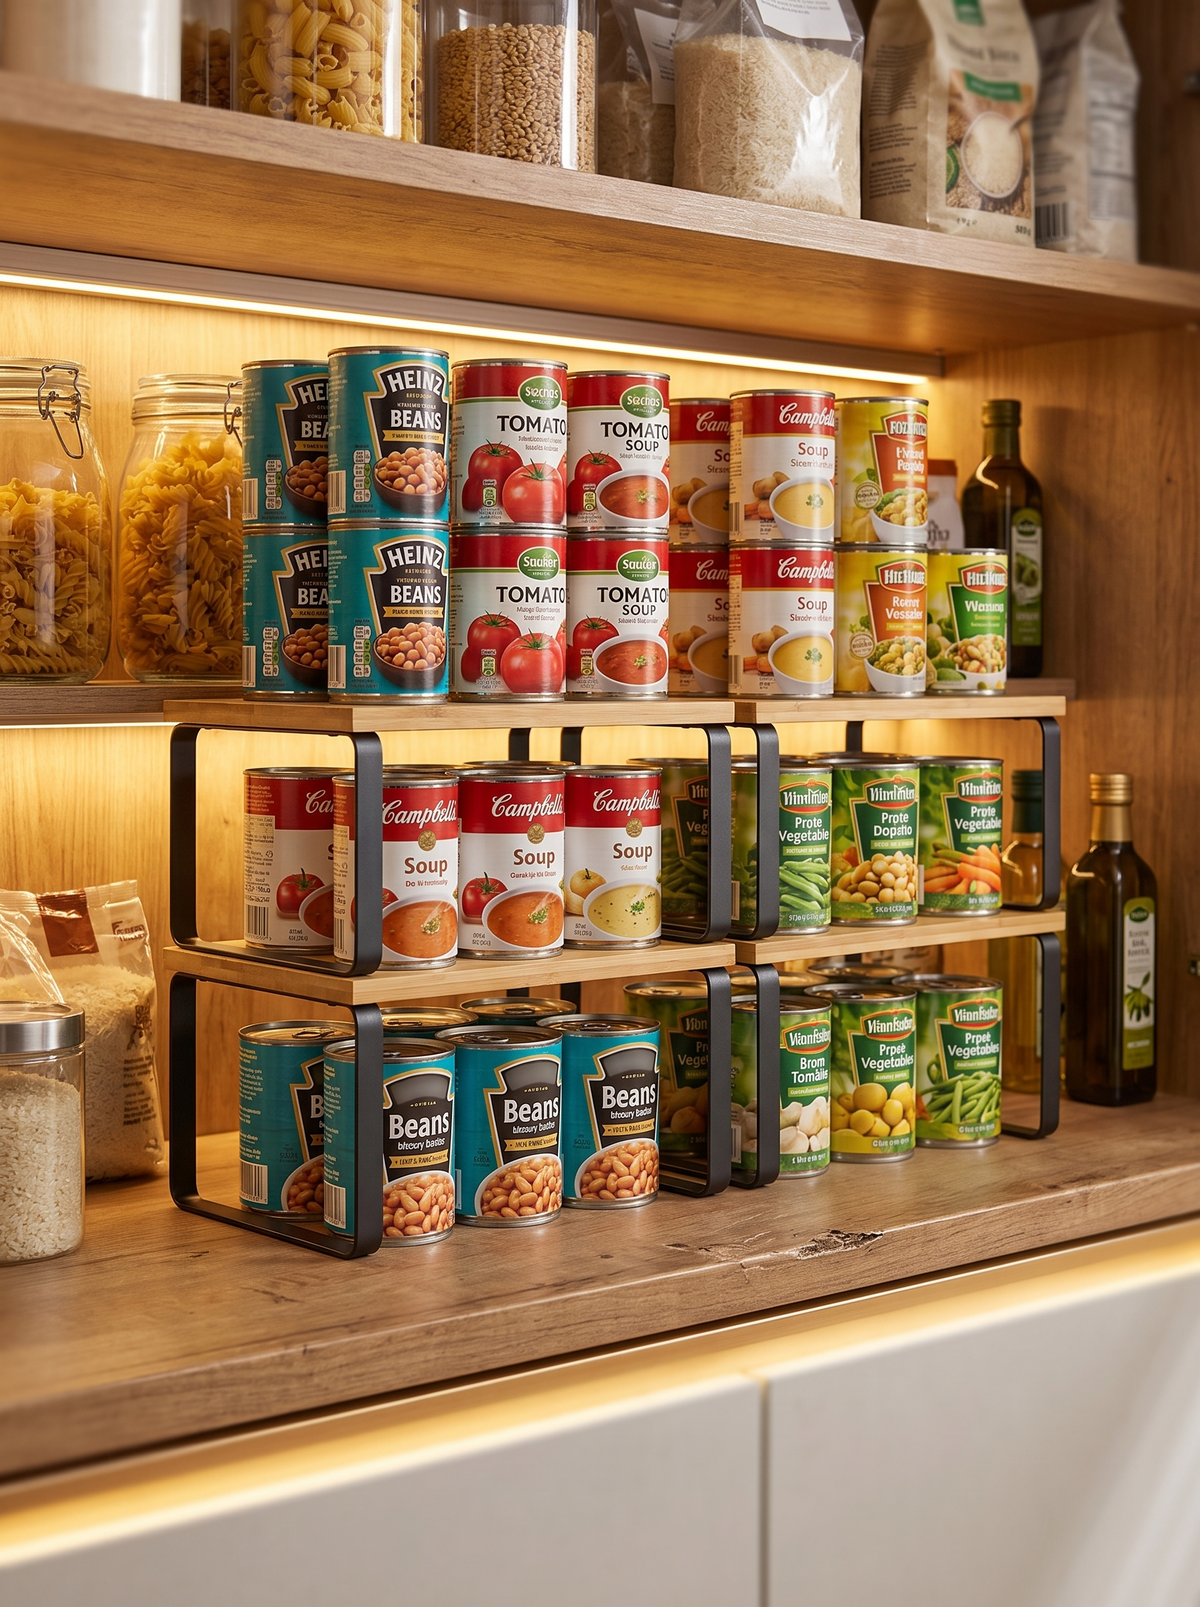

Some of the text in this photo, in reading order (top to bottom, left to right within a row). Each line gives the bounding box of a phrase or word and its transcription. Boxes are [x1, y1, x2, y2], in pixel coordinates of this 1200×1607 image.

[387, 370, 443, 396] HEINZ
[390, 409, 442, 431] BEANS
[496, 415, 567, 436] TOMATO
[600, 421, 669, 441] TOMATO
[626, 440, 660, 452] SOUP
[798, 442, 829, 460] Soup
[387, 545, 443, 570] HEINZ
[390, 585, 441, 604] BEANS
[496, 586, 566, 604] TOMATO
[597, 587, 667, 603] TOMATO
[622, 604, 656, 616] SOUP
[797, 597, 828, 614] Soup
[795, 817, 823, 829] Prote
[513, 848, 555, 869] Soup
[613, 842, 653, 862] Soup
[404, 857, 448, 877] Soup
[947, 1042, 1000, 1060] Vegetables
[800, 1057, 826, 1070] Brom
[861, 1054, 914, 1072] Vegetables
[602, 1083, 656, 1109] Beans
[503, 1097, 559, 1124] Beans
[388, 1112, 450, 1140] Beans
